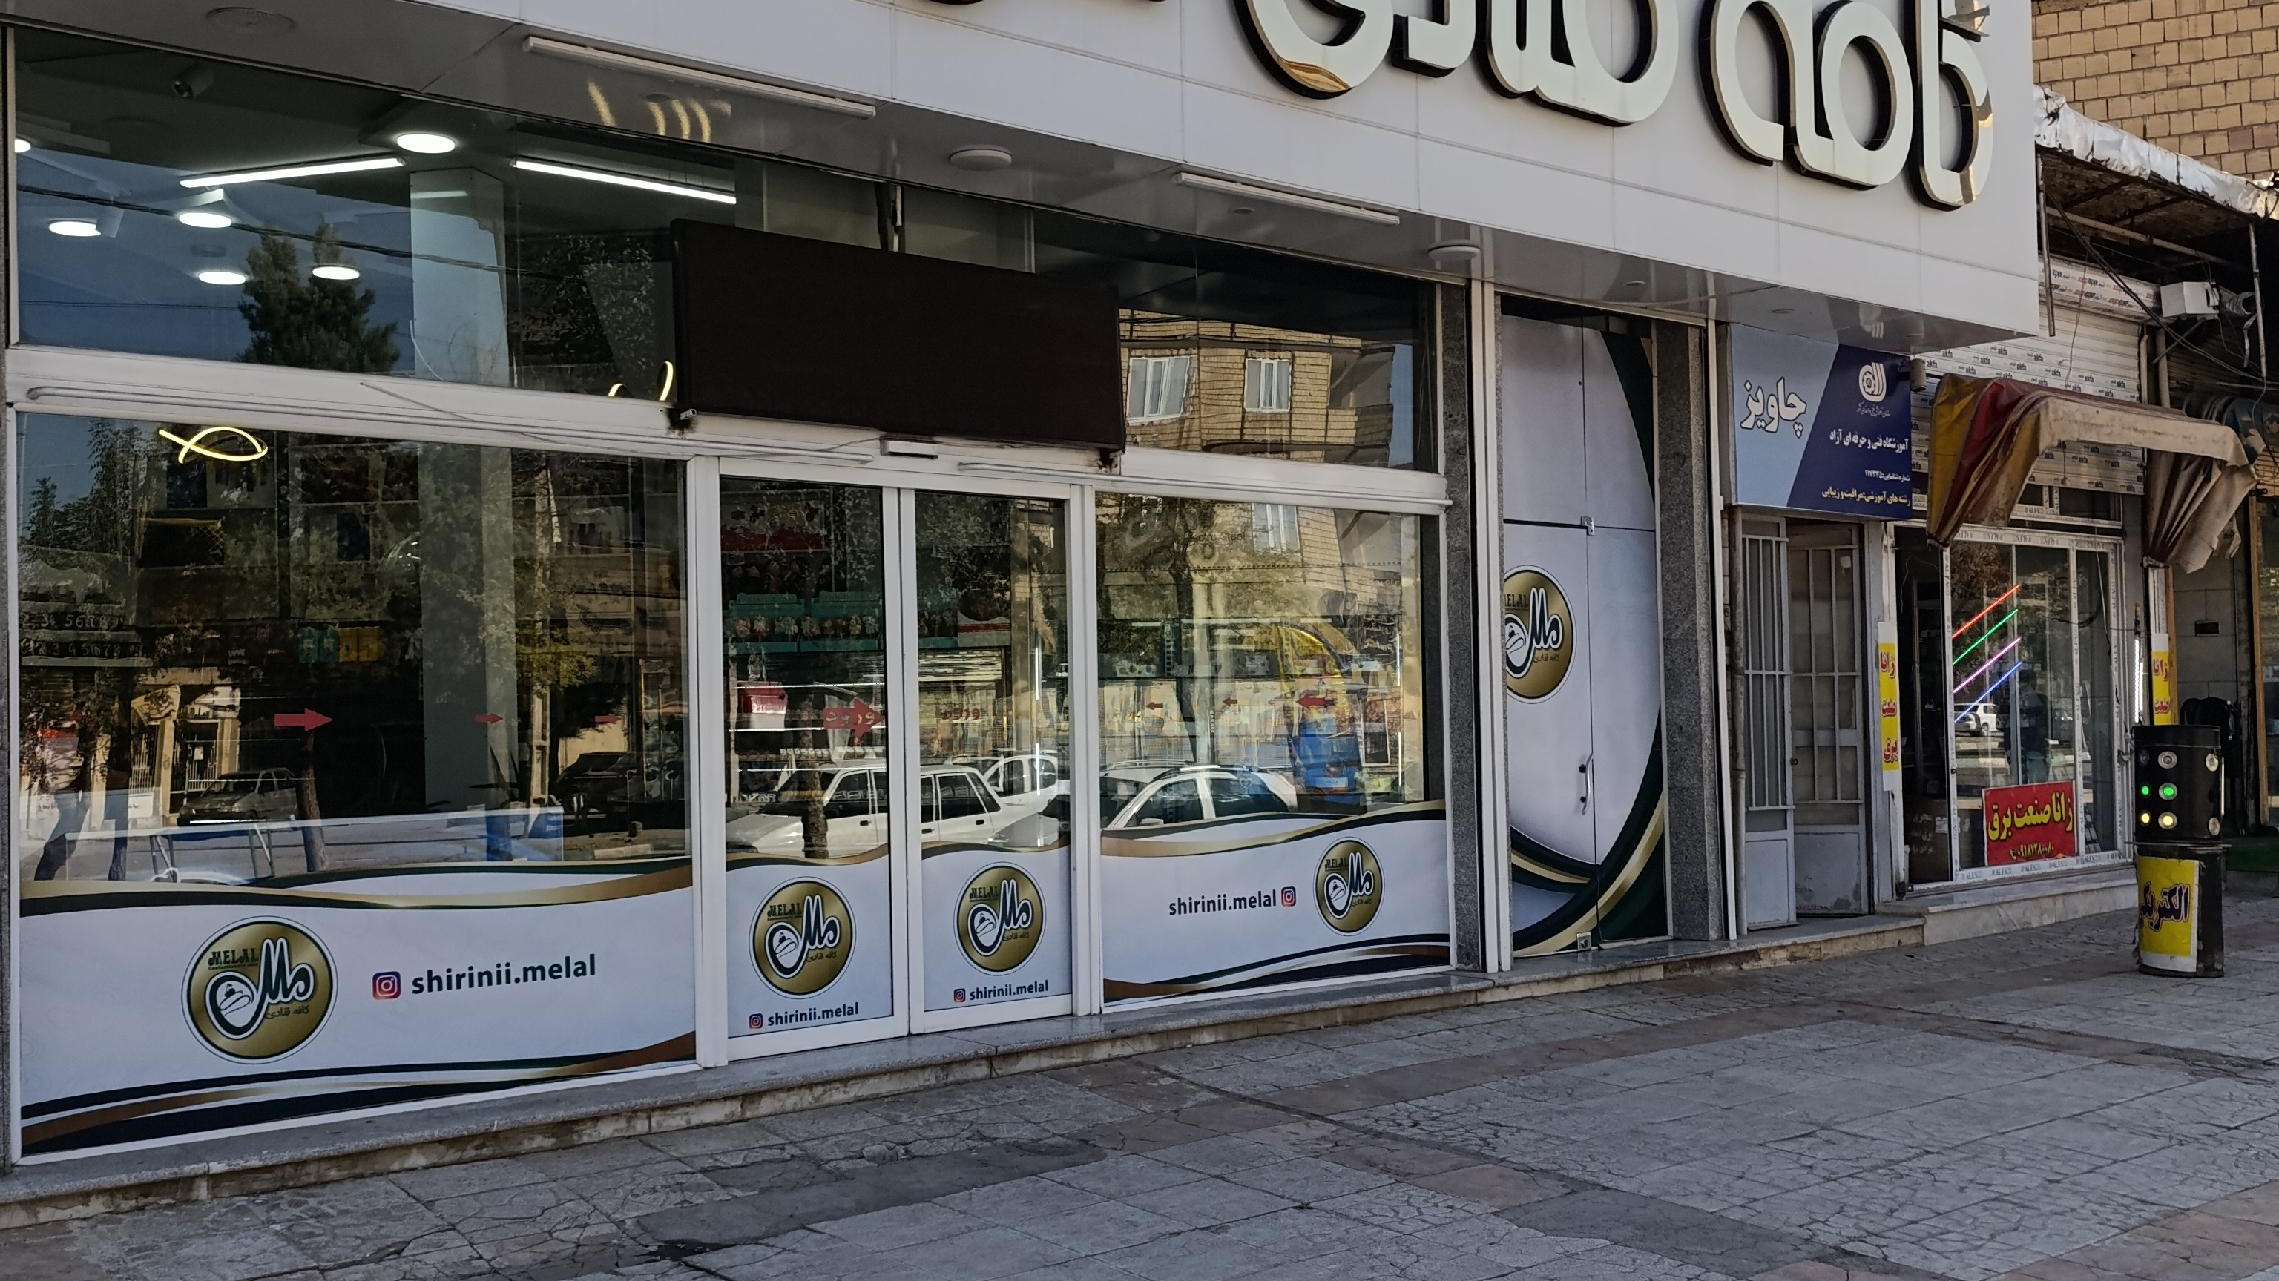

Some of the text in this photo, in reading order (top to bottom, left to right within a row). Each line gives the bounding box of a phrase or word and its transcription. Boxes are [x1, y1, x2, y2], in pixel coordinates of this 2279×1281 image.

[1740, 377, 1807, 439] چاویز
[1988, 792, 2073, 841] زانا صنعت برق
[1169, 888, 1277, 916] shirinii.melal
[207, 947, 259, 967] MELAL
[411, 953, 597, 995] shirinii.melal
[968, 979, 1050, 1001] shirinii.melal
[767, 1001, 860, 1026] shirinii.melal
